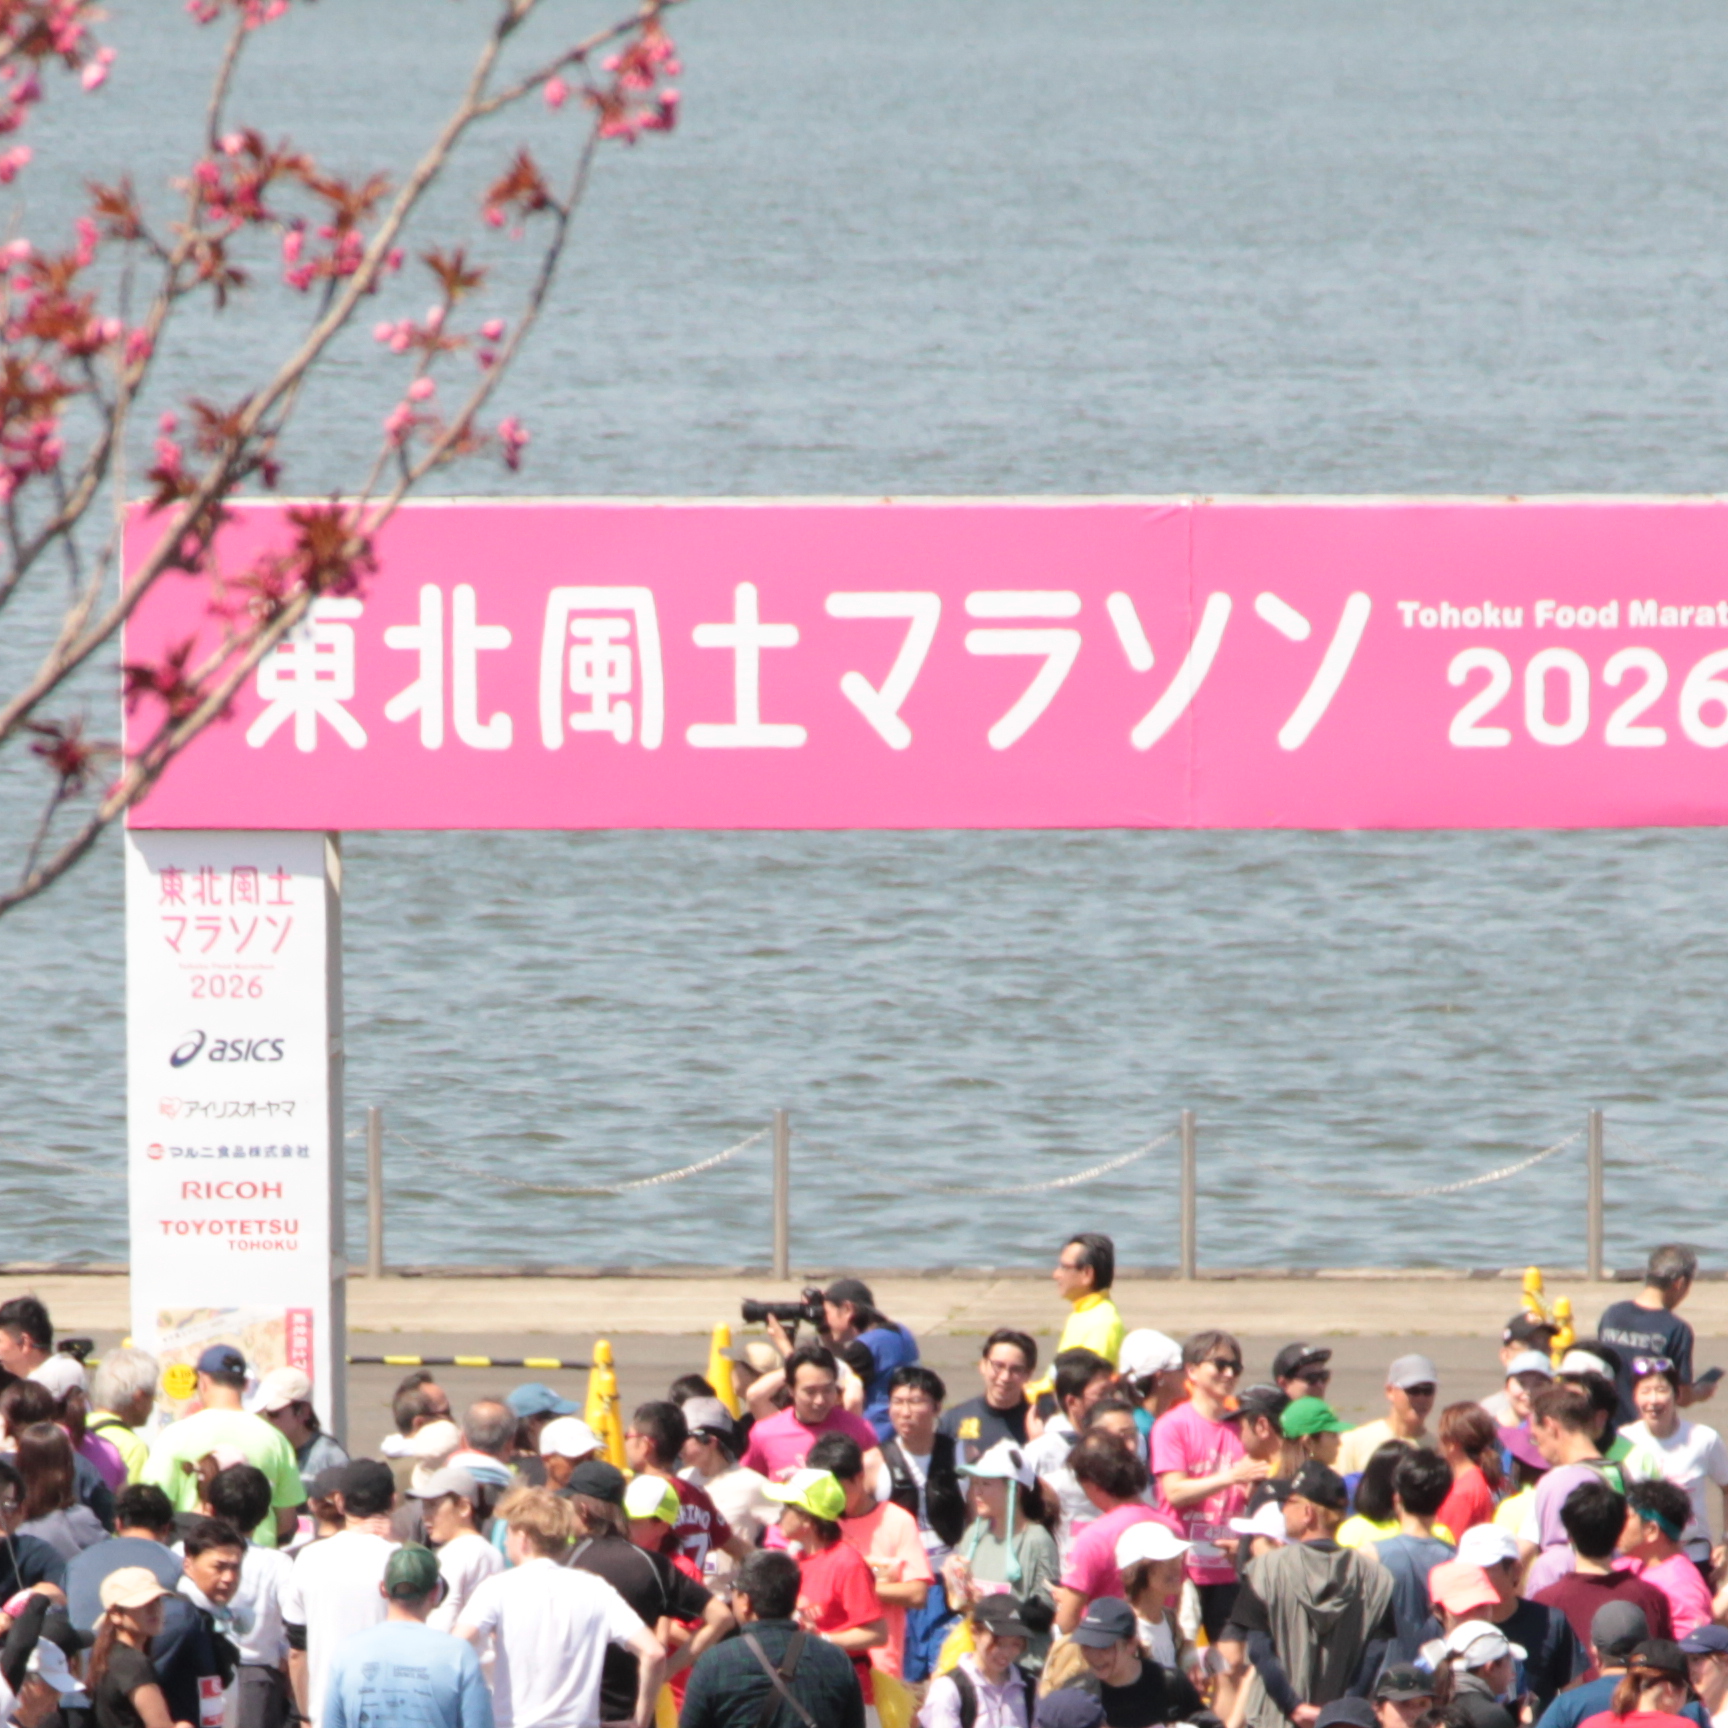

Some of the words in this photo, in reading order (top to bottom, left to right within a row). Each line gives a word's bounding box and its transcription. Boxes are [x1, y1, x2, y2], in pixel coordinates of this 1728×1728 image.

[1397, 600, 1524, 629] Tohoku
[1534, 599, 1620, 629] Food
[245, 581, 1371, 753] 東北風土マラソン
[158, 864, 295, 907] 東北風土
[160, 914, 294, 955] マラソン
[189, 973, 264, 1000] 2026
[183, 1100, 297, 1119] アイリスオーヤマ
[180, 1180, 284, 1200] RICOH
[158, 1218, 300, 1236] TOYOTETSU
[227, 1238, 299, 1251] TOHOKU
